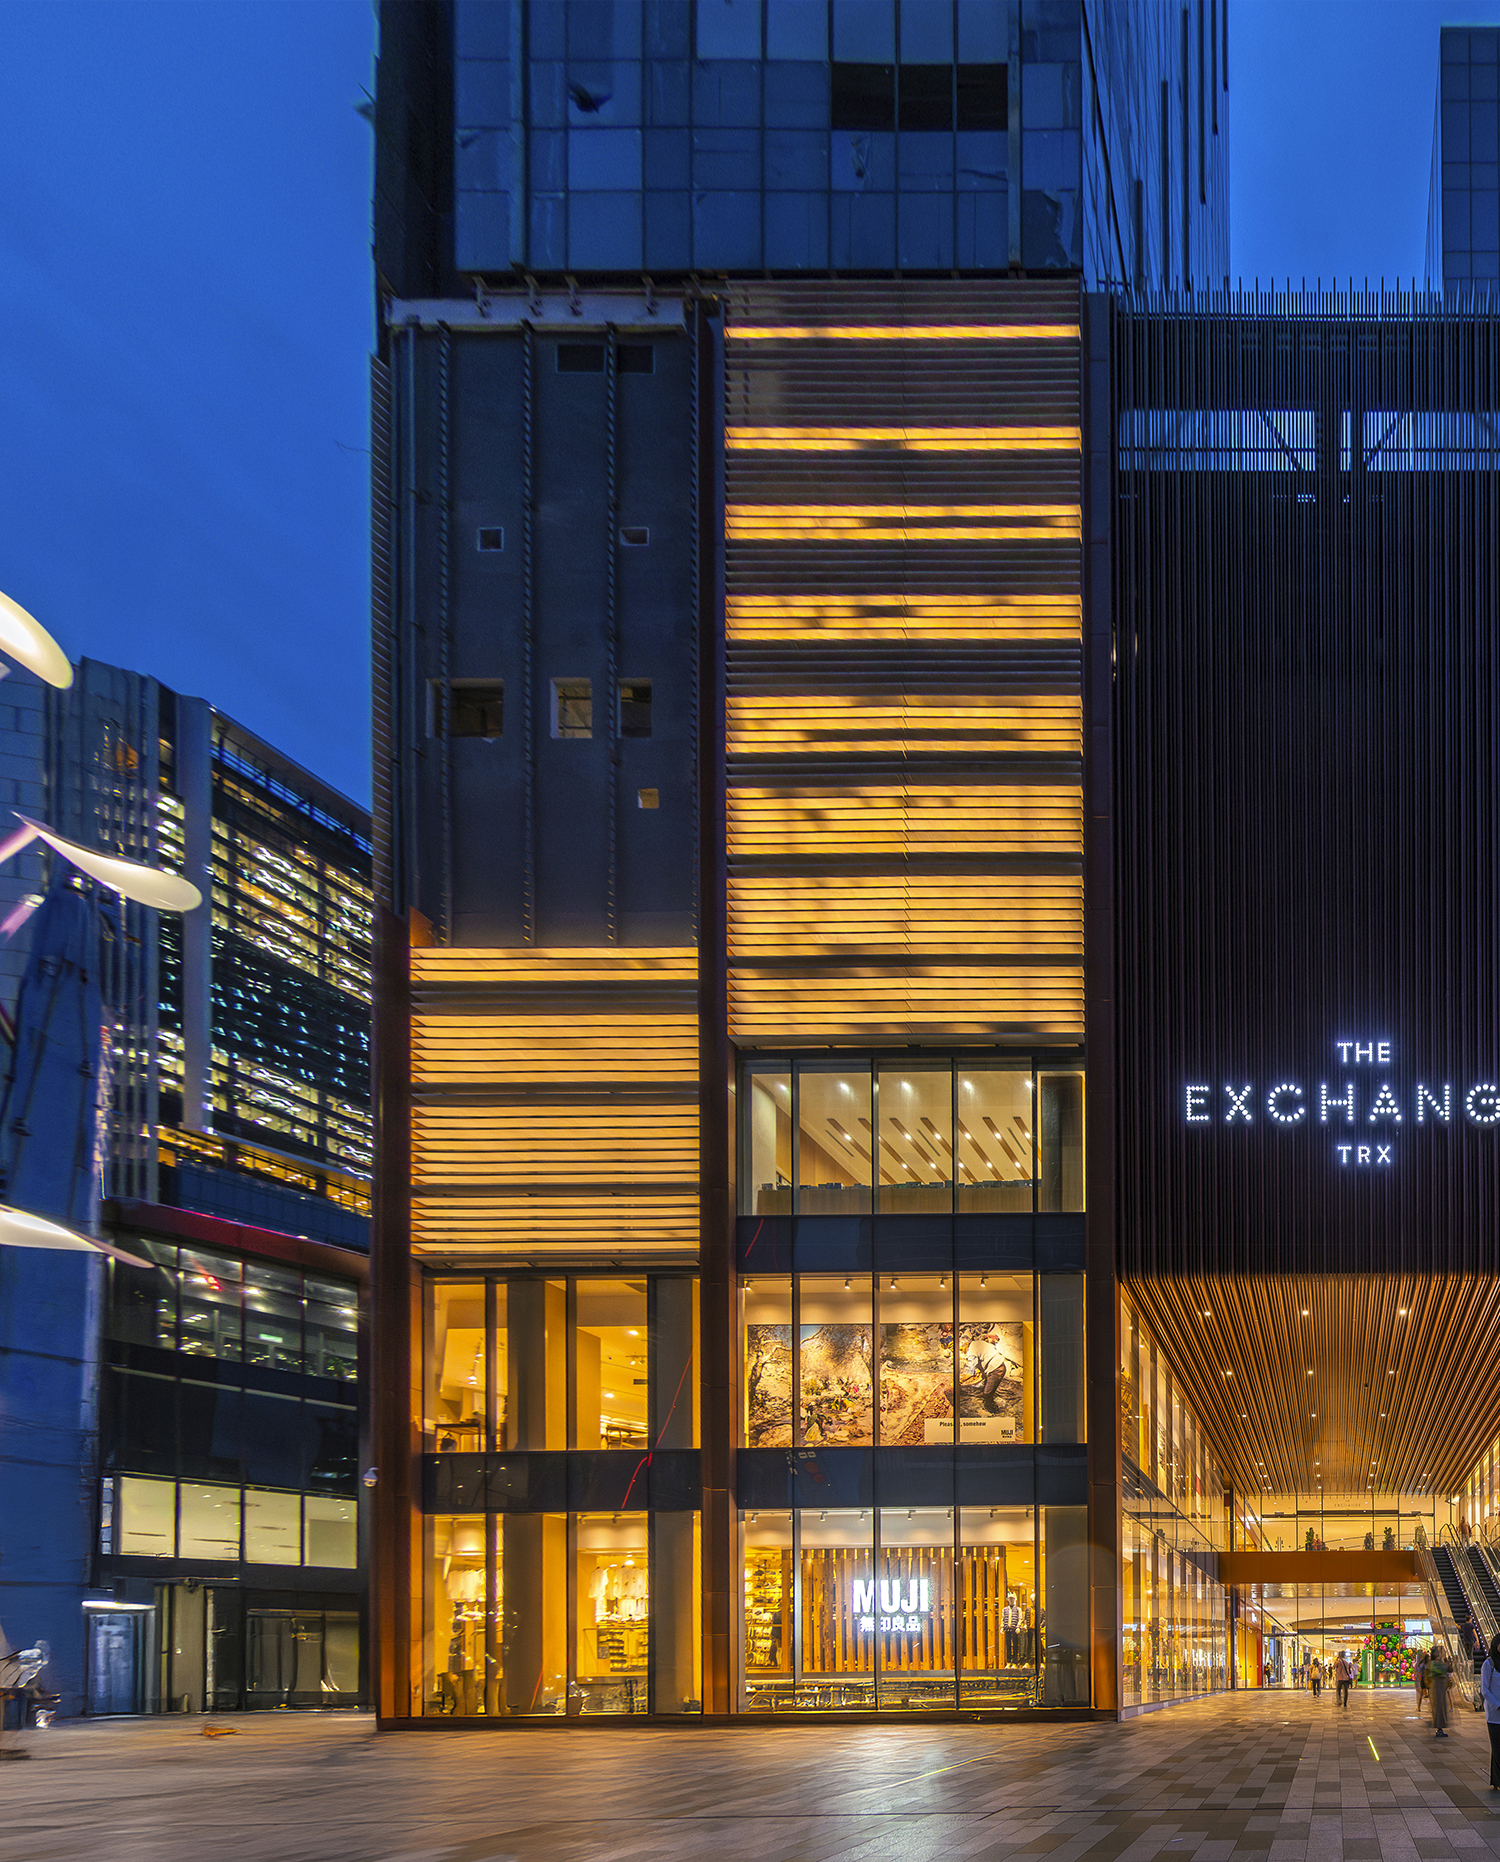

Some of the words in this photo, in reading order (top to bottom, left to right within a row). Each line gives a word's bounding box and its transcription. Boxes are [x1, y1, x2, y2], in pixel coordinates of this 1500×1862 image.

[1337, 1042, 1391, 1063] THE
[1337, 1145, 1391, 1163] TRX
[852, 1579, 929, 1614] MUJI
[859, 1615, 921, 1633] 無印良品
